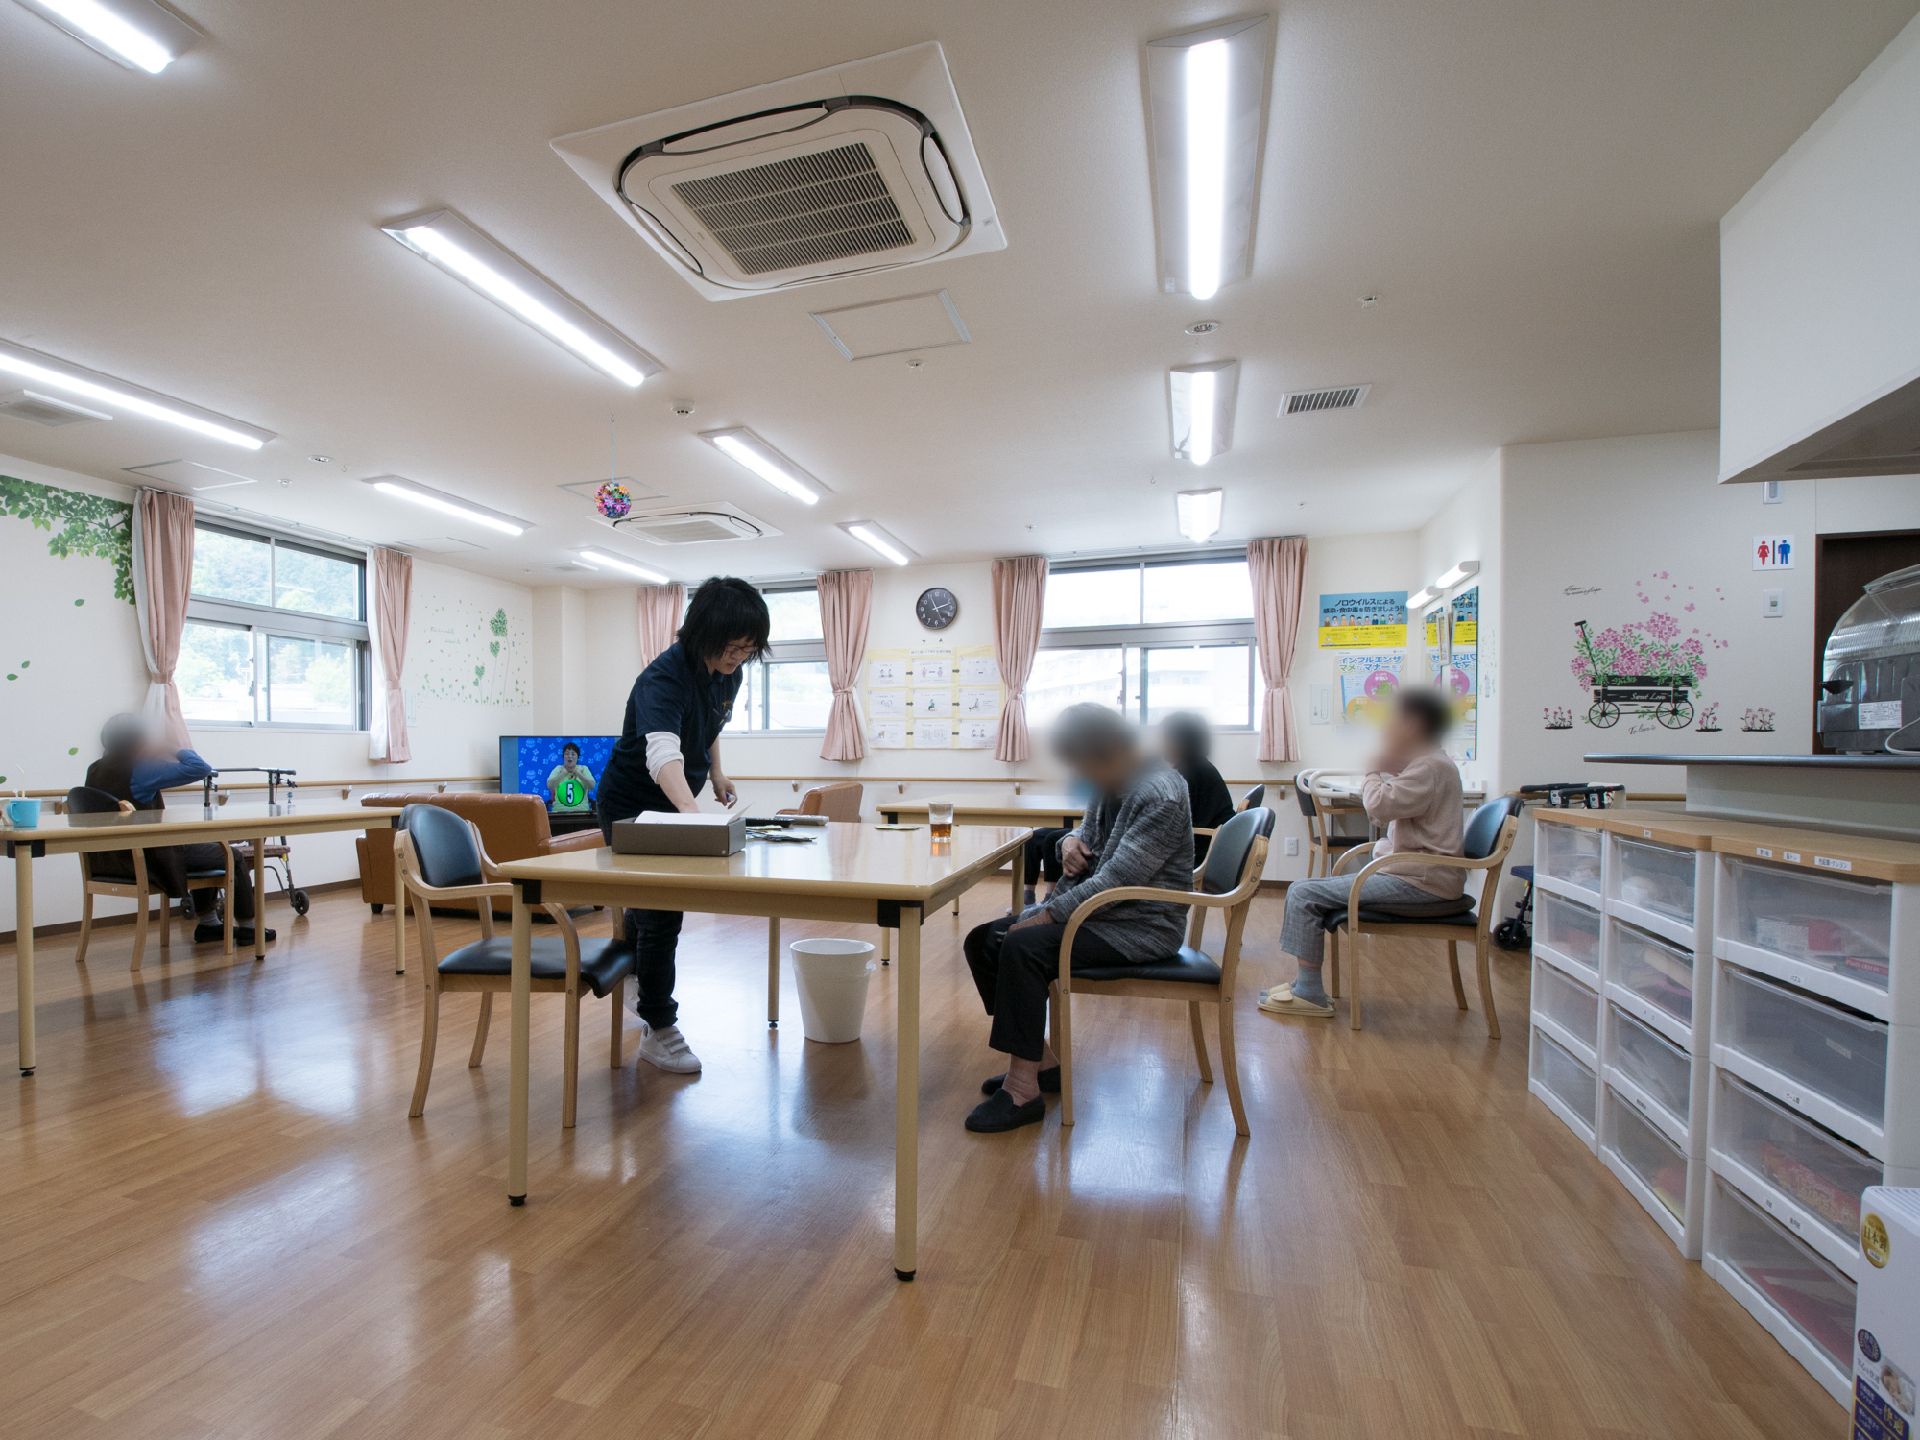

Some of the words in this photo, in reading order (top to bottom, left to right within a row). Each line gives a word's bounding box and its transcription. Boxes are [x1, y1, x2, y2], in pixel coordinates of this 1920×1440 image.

[1334, 598, 1396, 607] ノロウイルスによる
[566, 783, 574, 804] 5
